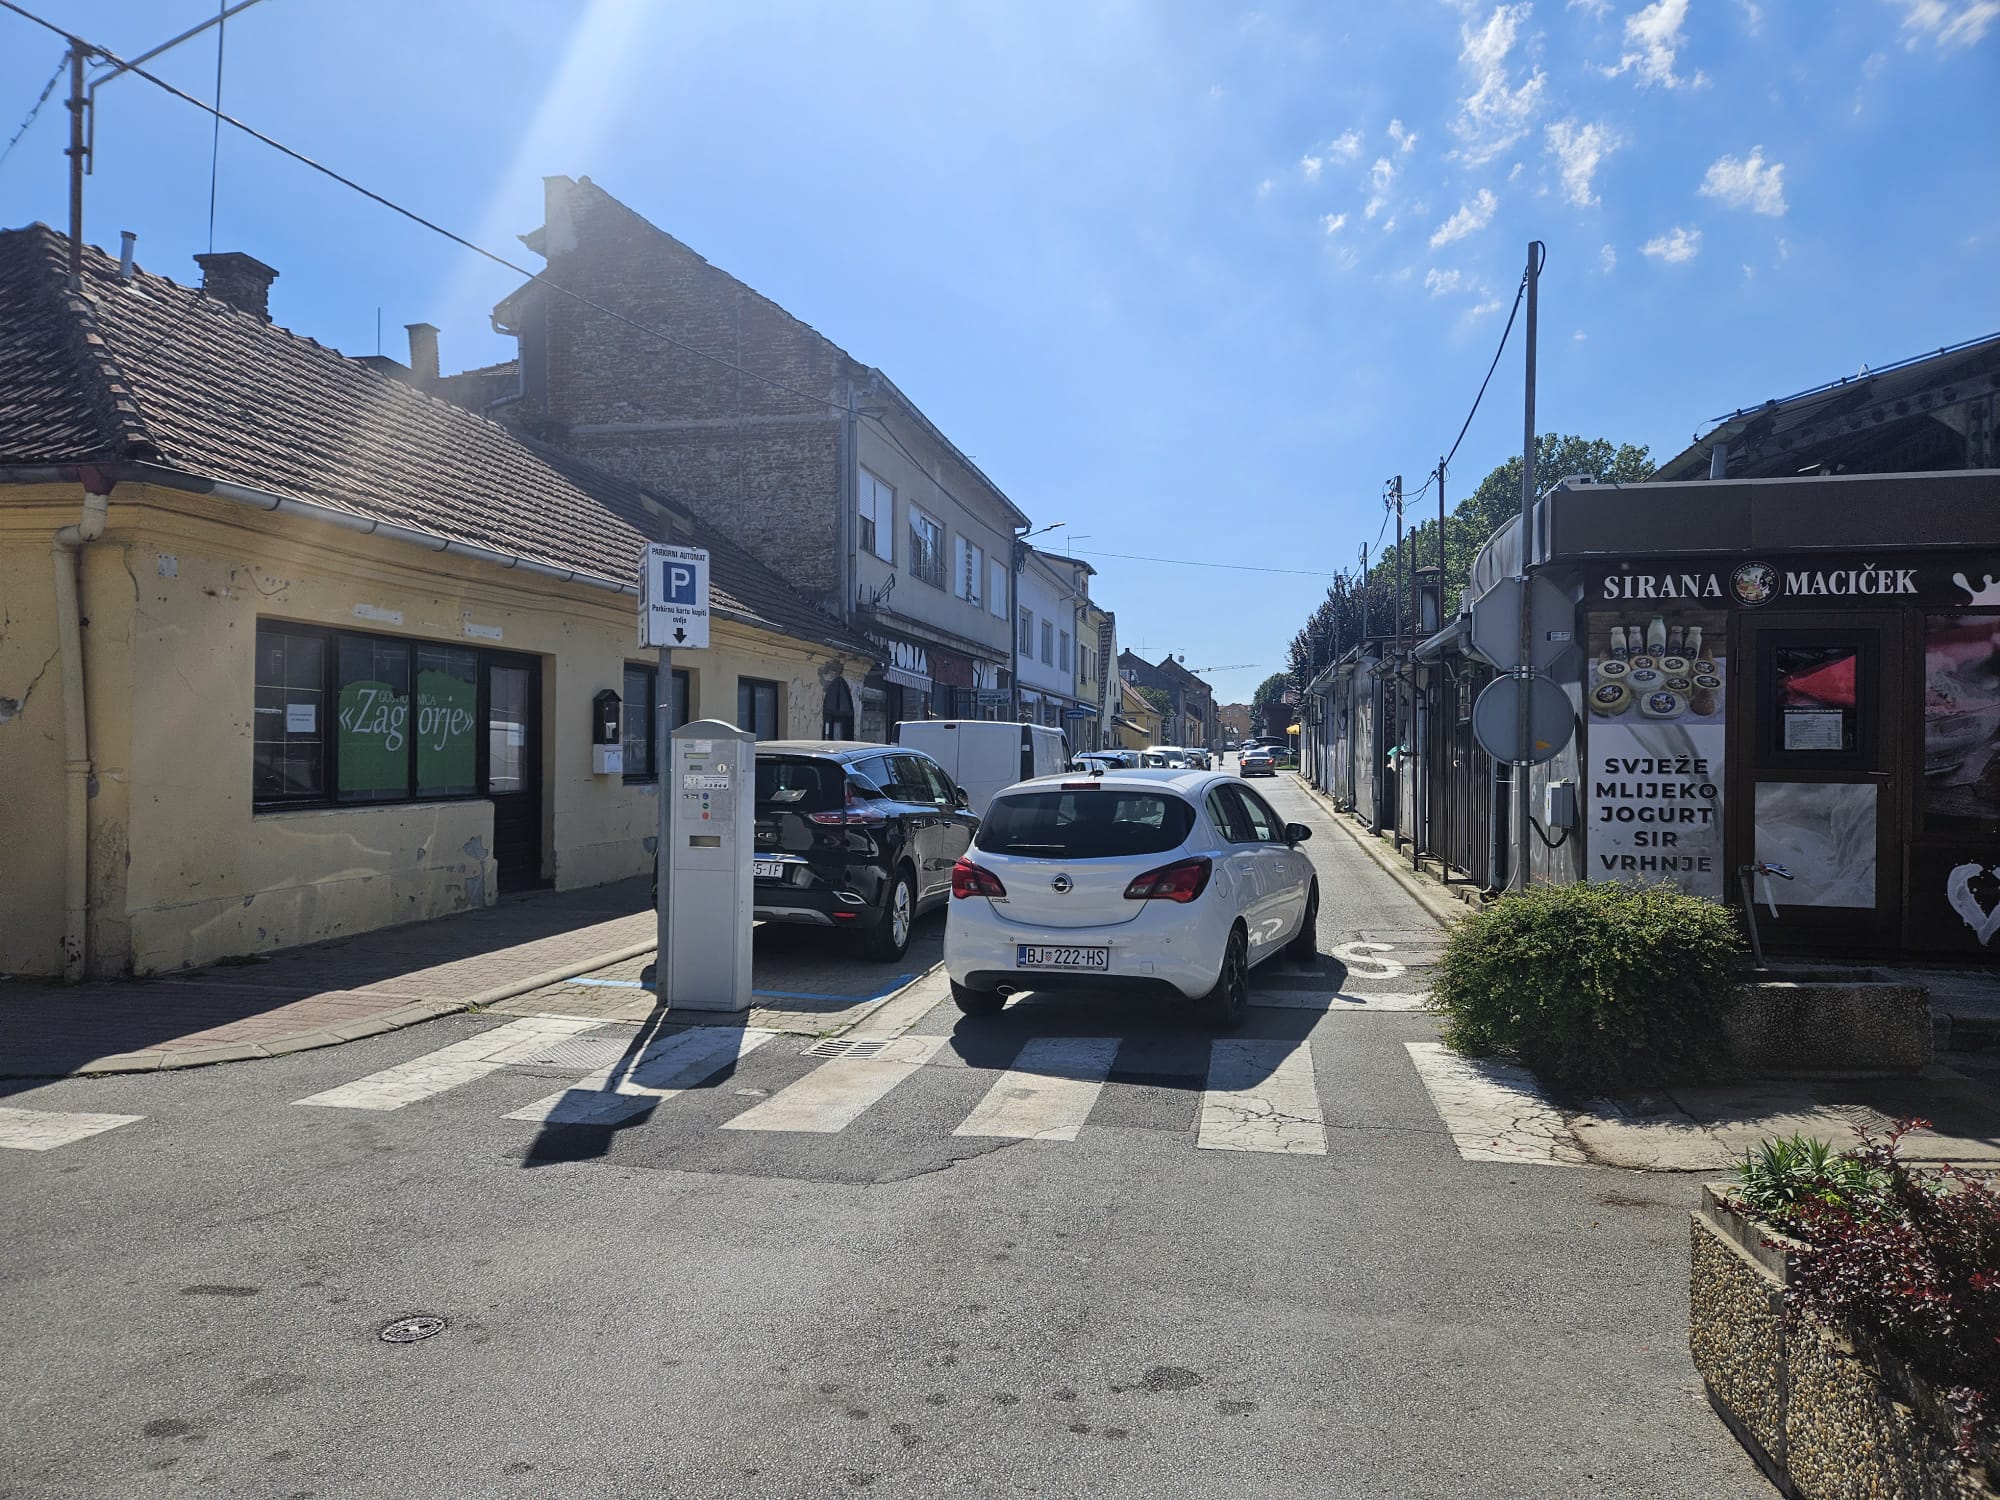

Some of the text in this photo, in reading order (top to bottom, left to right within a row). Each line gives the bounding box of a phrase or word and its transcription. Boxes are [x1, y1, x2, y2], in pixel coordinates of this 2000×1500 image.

[652, 547, 706, 562] PARKIRNI AUTOMAT
[671, 567, 690, 599] P
[1603, 574, 1723, 600] SIRANA
[1784, 562, 1919, 596] MACIČEK
[652, 604, 675, 614] Parkirnu
[676, 606, 690, 615] kartu
[673, 616, 687, 625] ovdje
[1605, 755, 1709, 775] SVJEŽE
[1596, 782, 1719, 799] MLIJEKO
[1600, 806, 1713, 824] JOGURT
[1634, 831, 1678, 848] SIR
[1600, 855, 1712, 873] VRHNJE
[1027, 948, 1105, 966] BJ 222-HS
